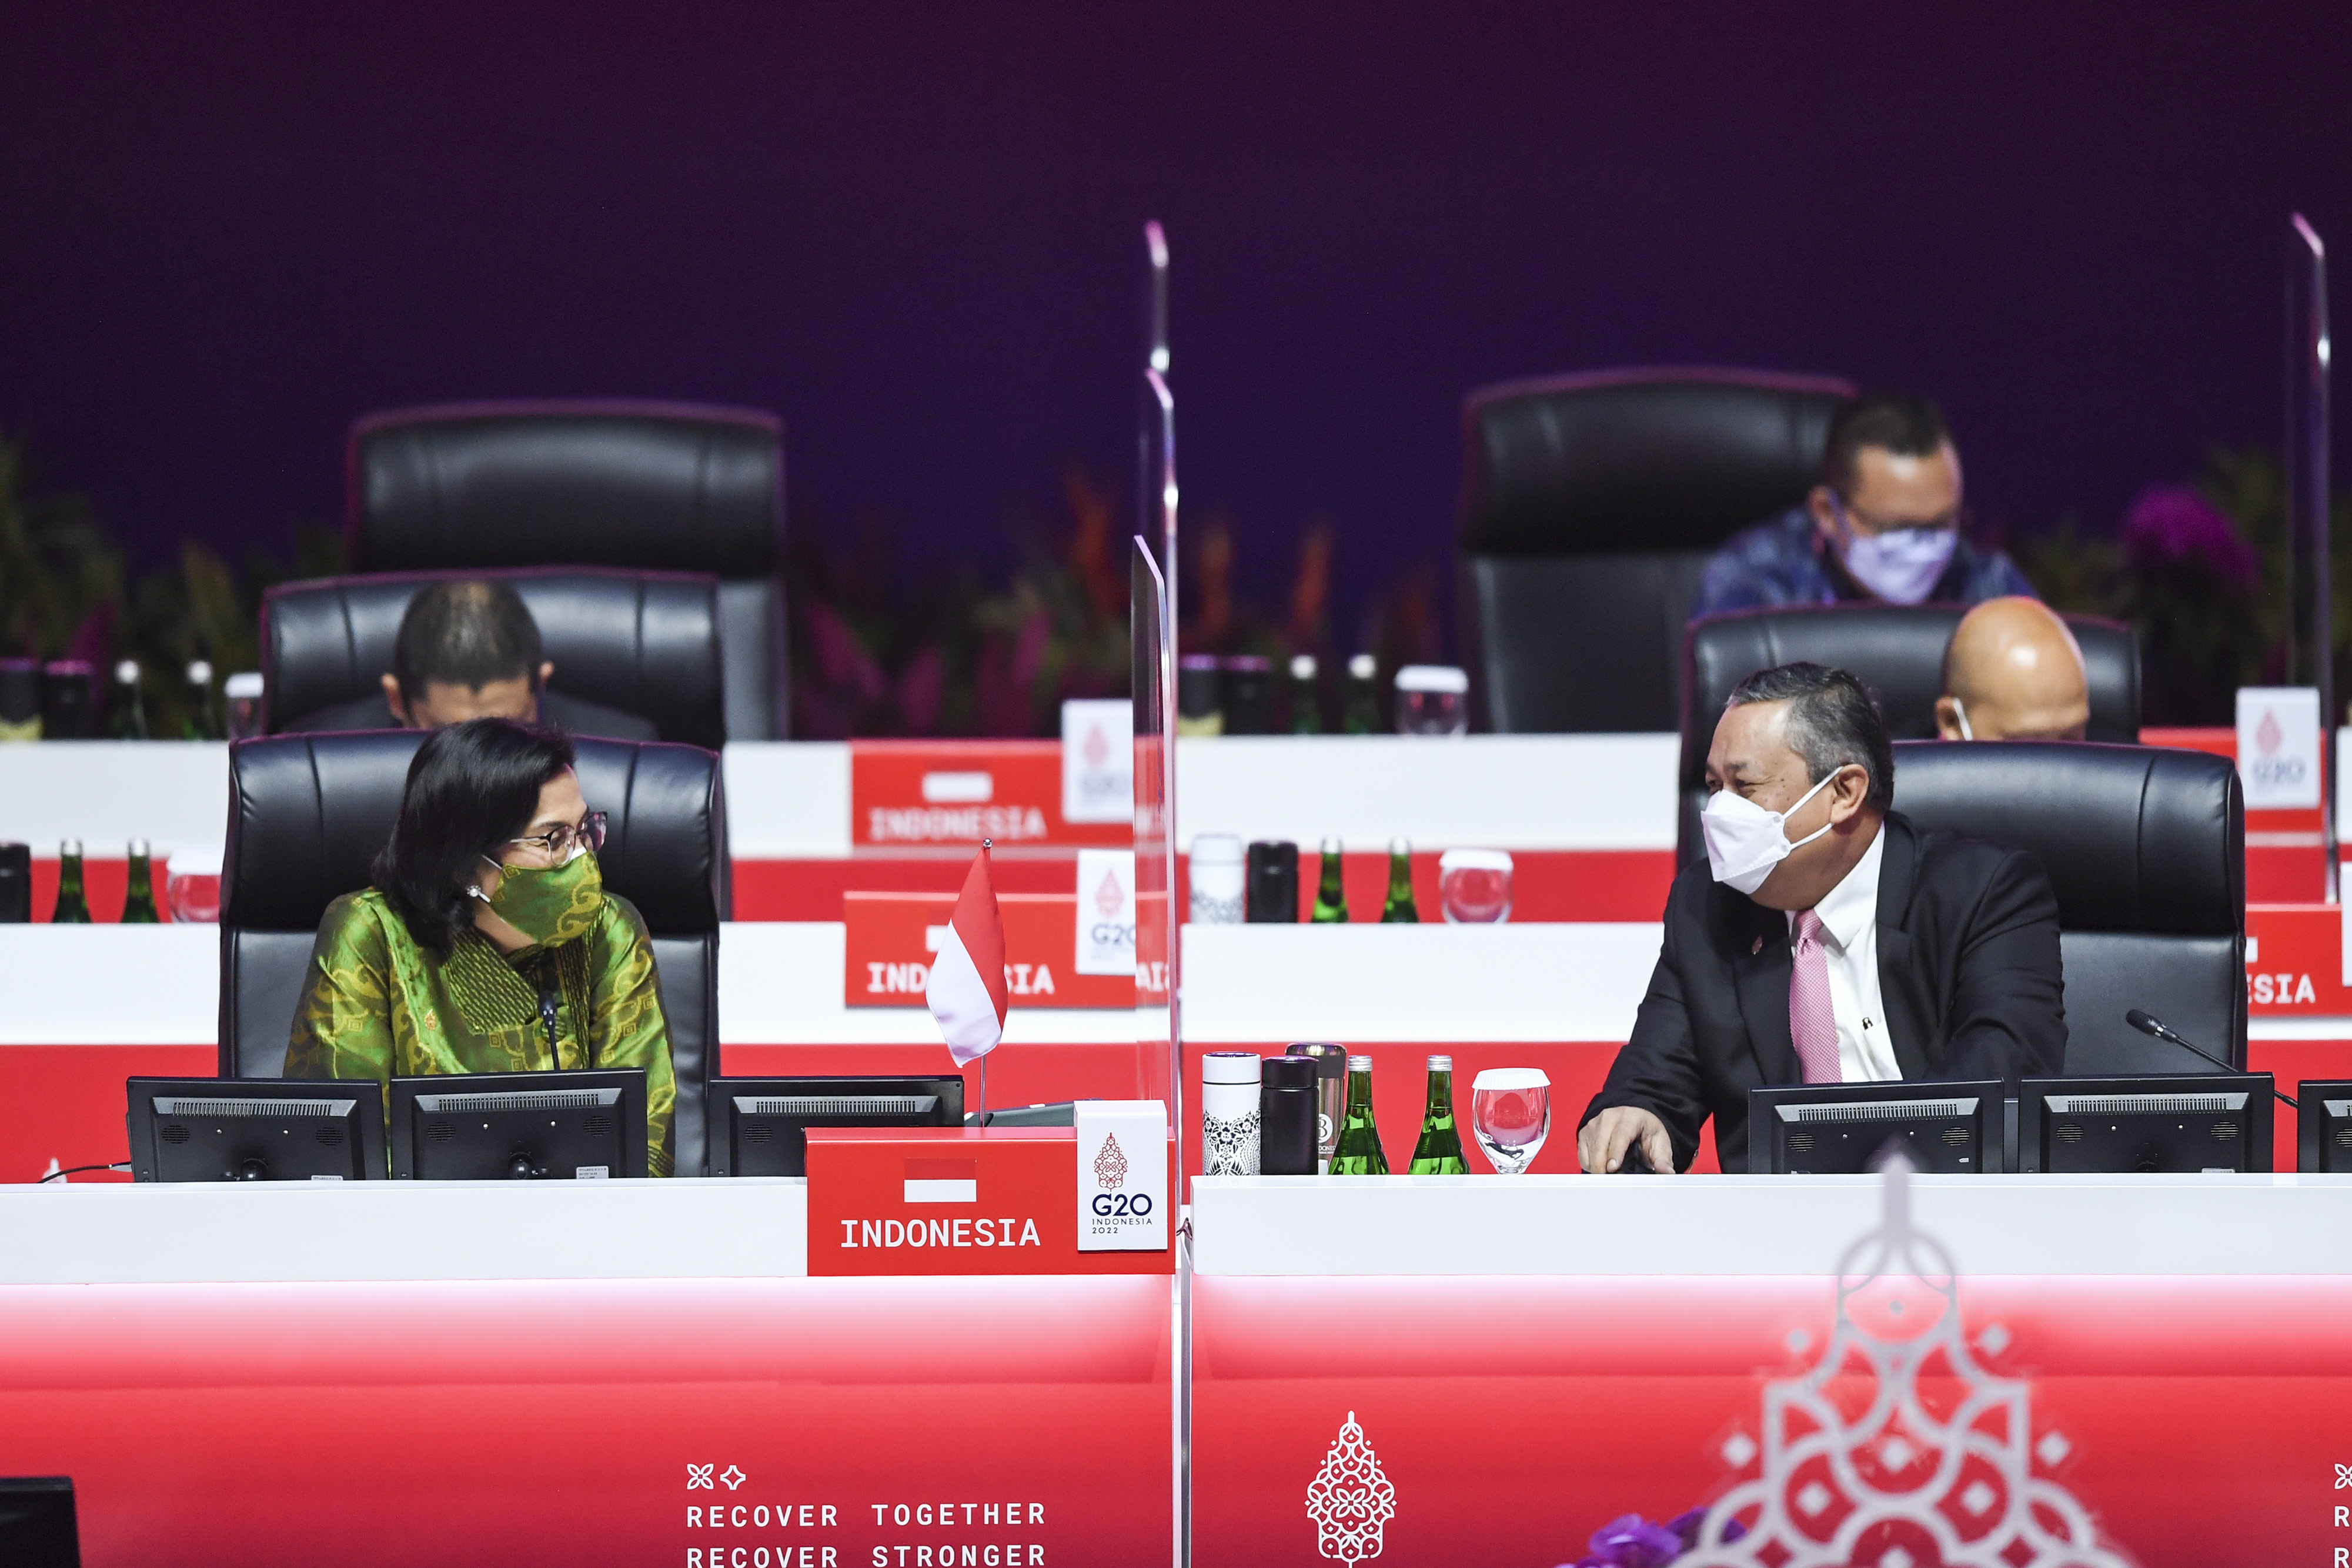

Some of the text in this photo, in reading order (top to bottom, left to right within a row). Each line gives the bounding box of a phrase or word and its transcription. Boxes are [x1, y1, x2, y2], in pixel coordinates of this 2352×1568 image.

[868, 807, 1047, 840] INDONESIA
[2246, 973, 2316, 1004] SIA
[1092, 1193, 1152, 1216] G20
[841, 1218, 1041, 1248] INDONESIA
[687, 1503, 1045, 1527] RECOVER TOGETHER
[687, 1544, 1045, 1568] RECOVER STRONGER
